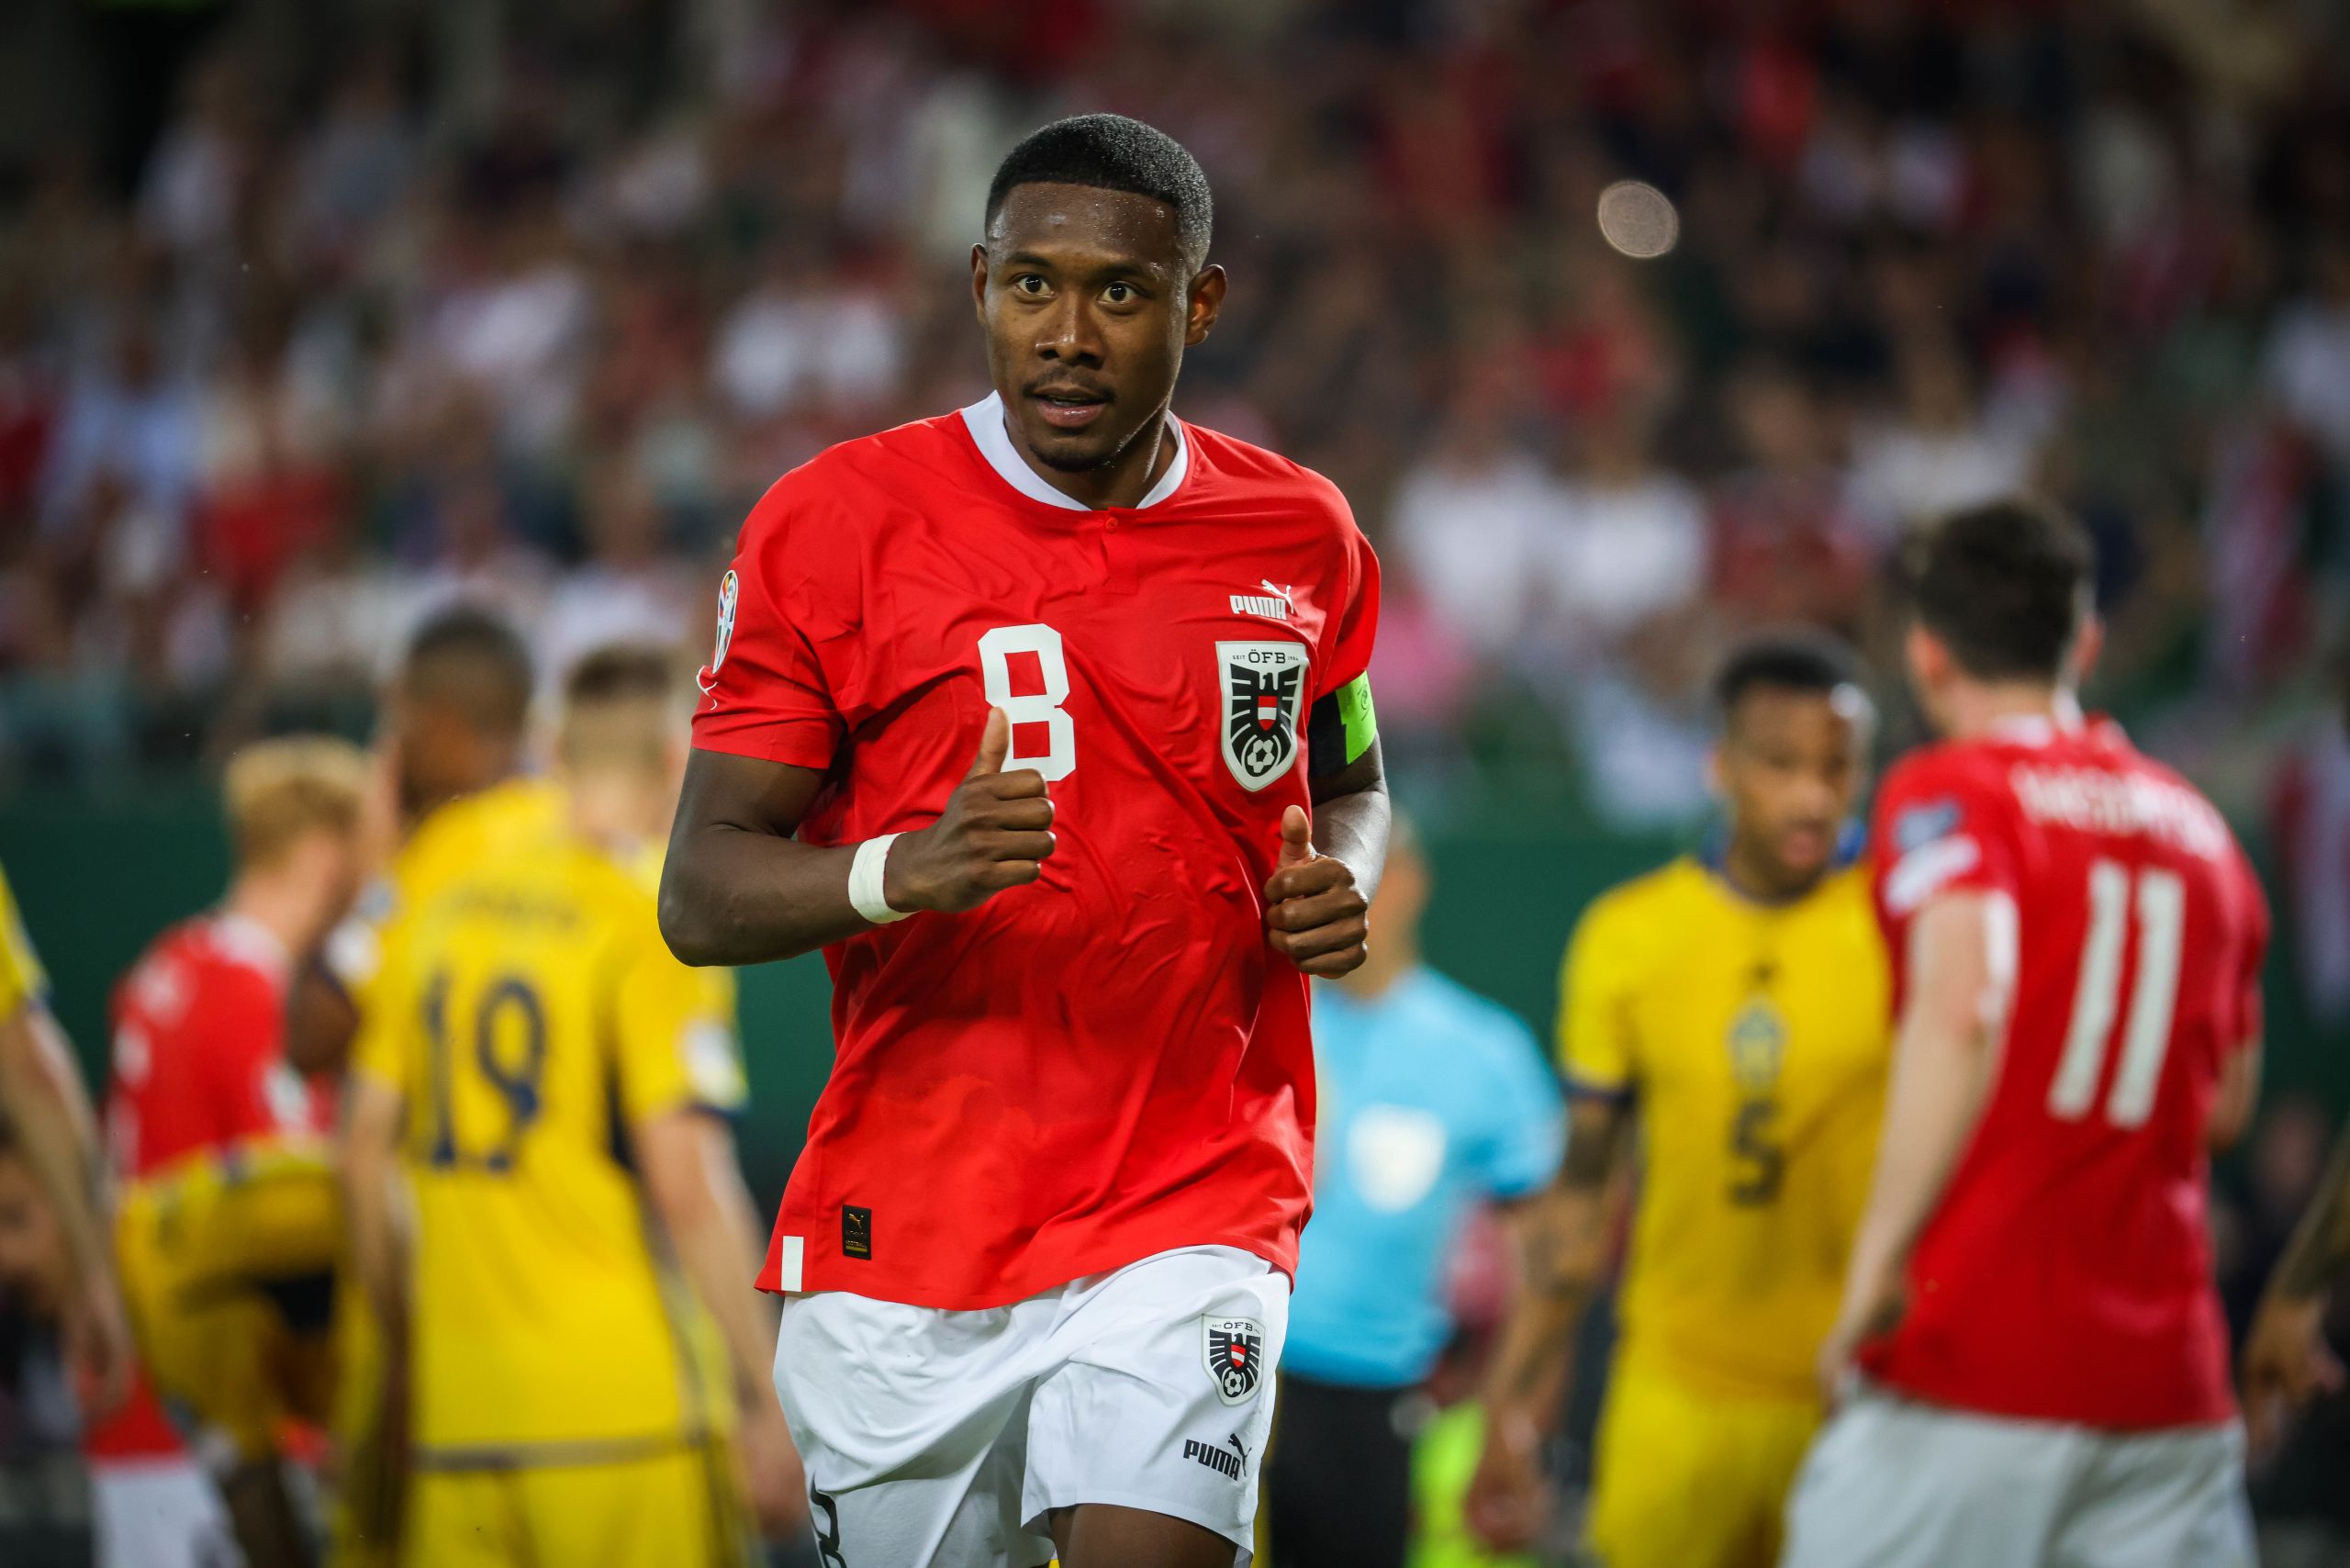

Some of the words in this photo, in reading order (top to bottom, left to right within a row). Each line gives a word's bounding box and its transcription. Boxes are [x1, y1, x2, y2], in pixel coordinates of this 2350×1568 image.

[1229, 595, 1287, 620] PUMA
[1248, 648, 1286, 664] ÖFB
[978, 623, 1076, 781] 8
[2046, 858, 2186, 1131] 11
[421, 967, 549, 1172] 19
[1728, 1099, 1786, 1206] 5
[1224, 1321, 1253, 1332] ÖFB
[1183, 1439, 1240, 1482] PUMA
